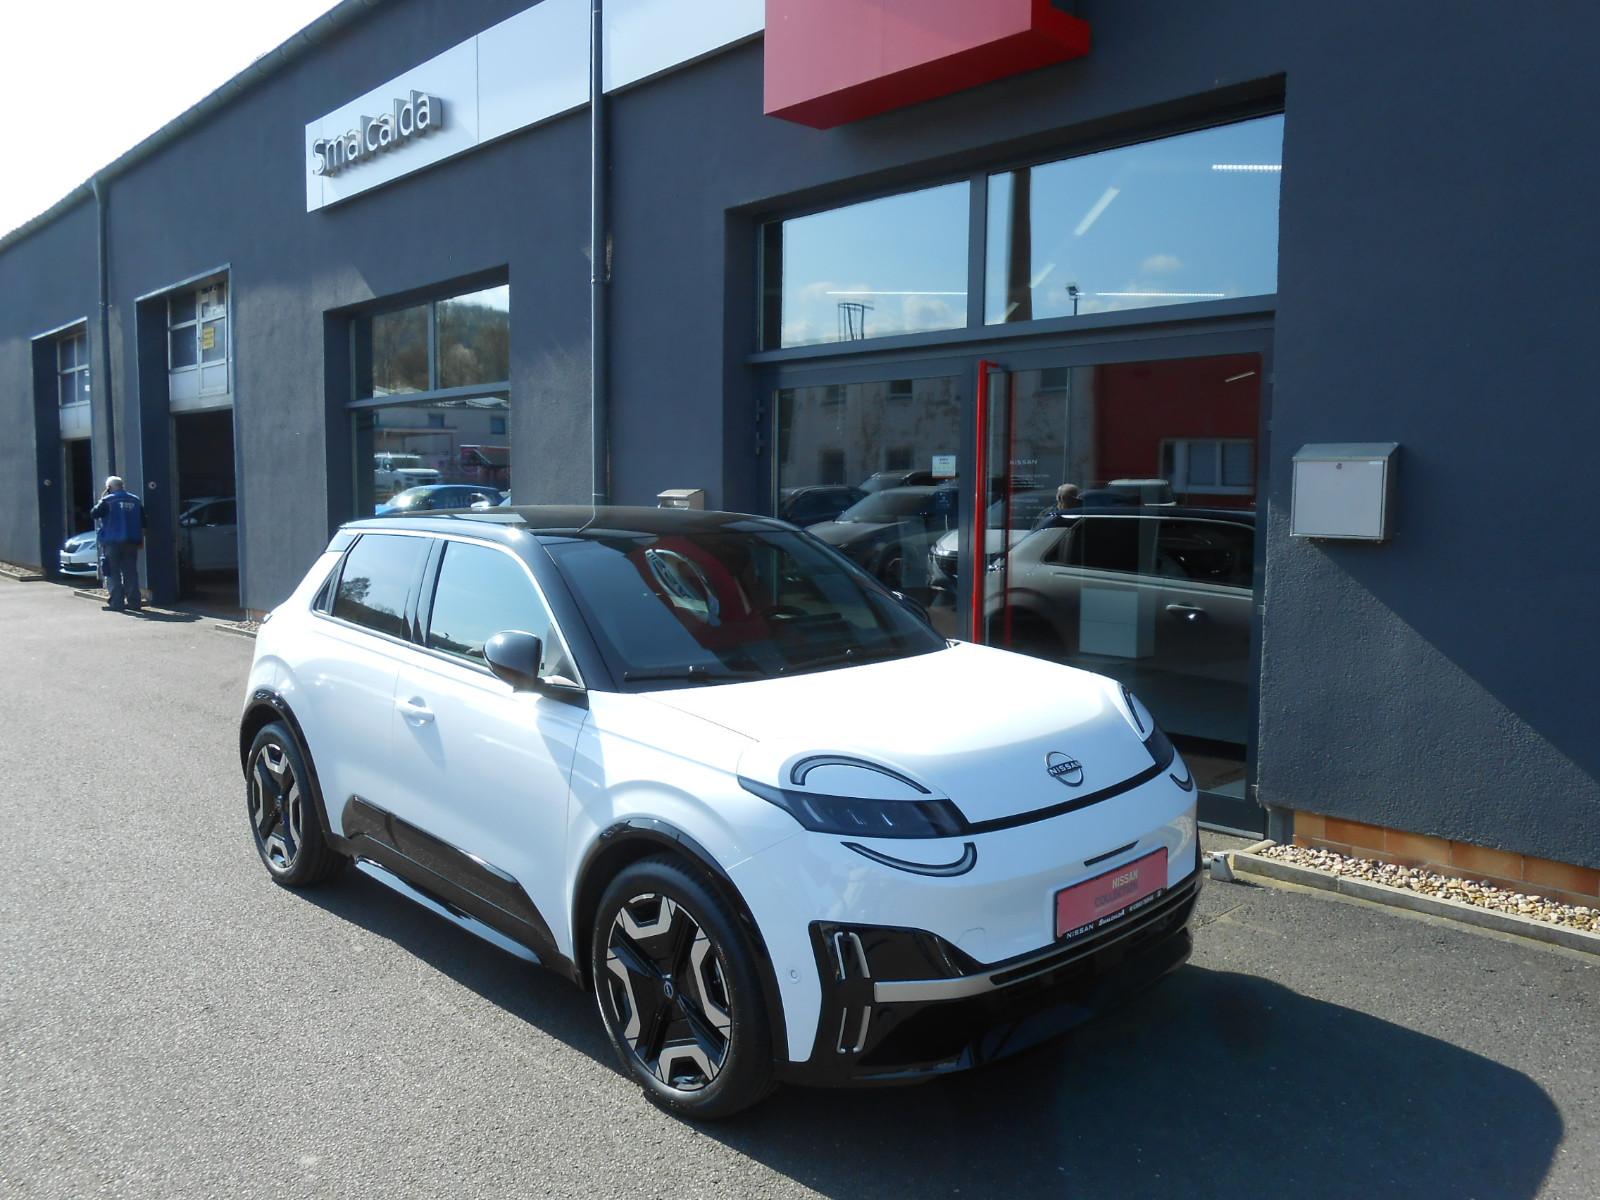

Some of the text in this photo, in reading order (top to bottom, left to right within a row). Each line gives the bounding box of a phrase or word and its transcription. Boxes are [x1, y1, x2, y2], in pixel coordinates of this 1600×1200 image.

[313, 90, 435, 175] Smalcalda
[1049, 760, 1081, 775] NISSAN
[1112, 869, 1138, 888] NISSAN
[1066, 924, 1094, 939] NISSAN
